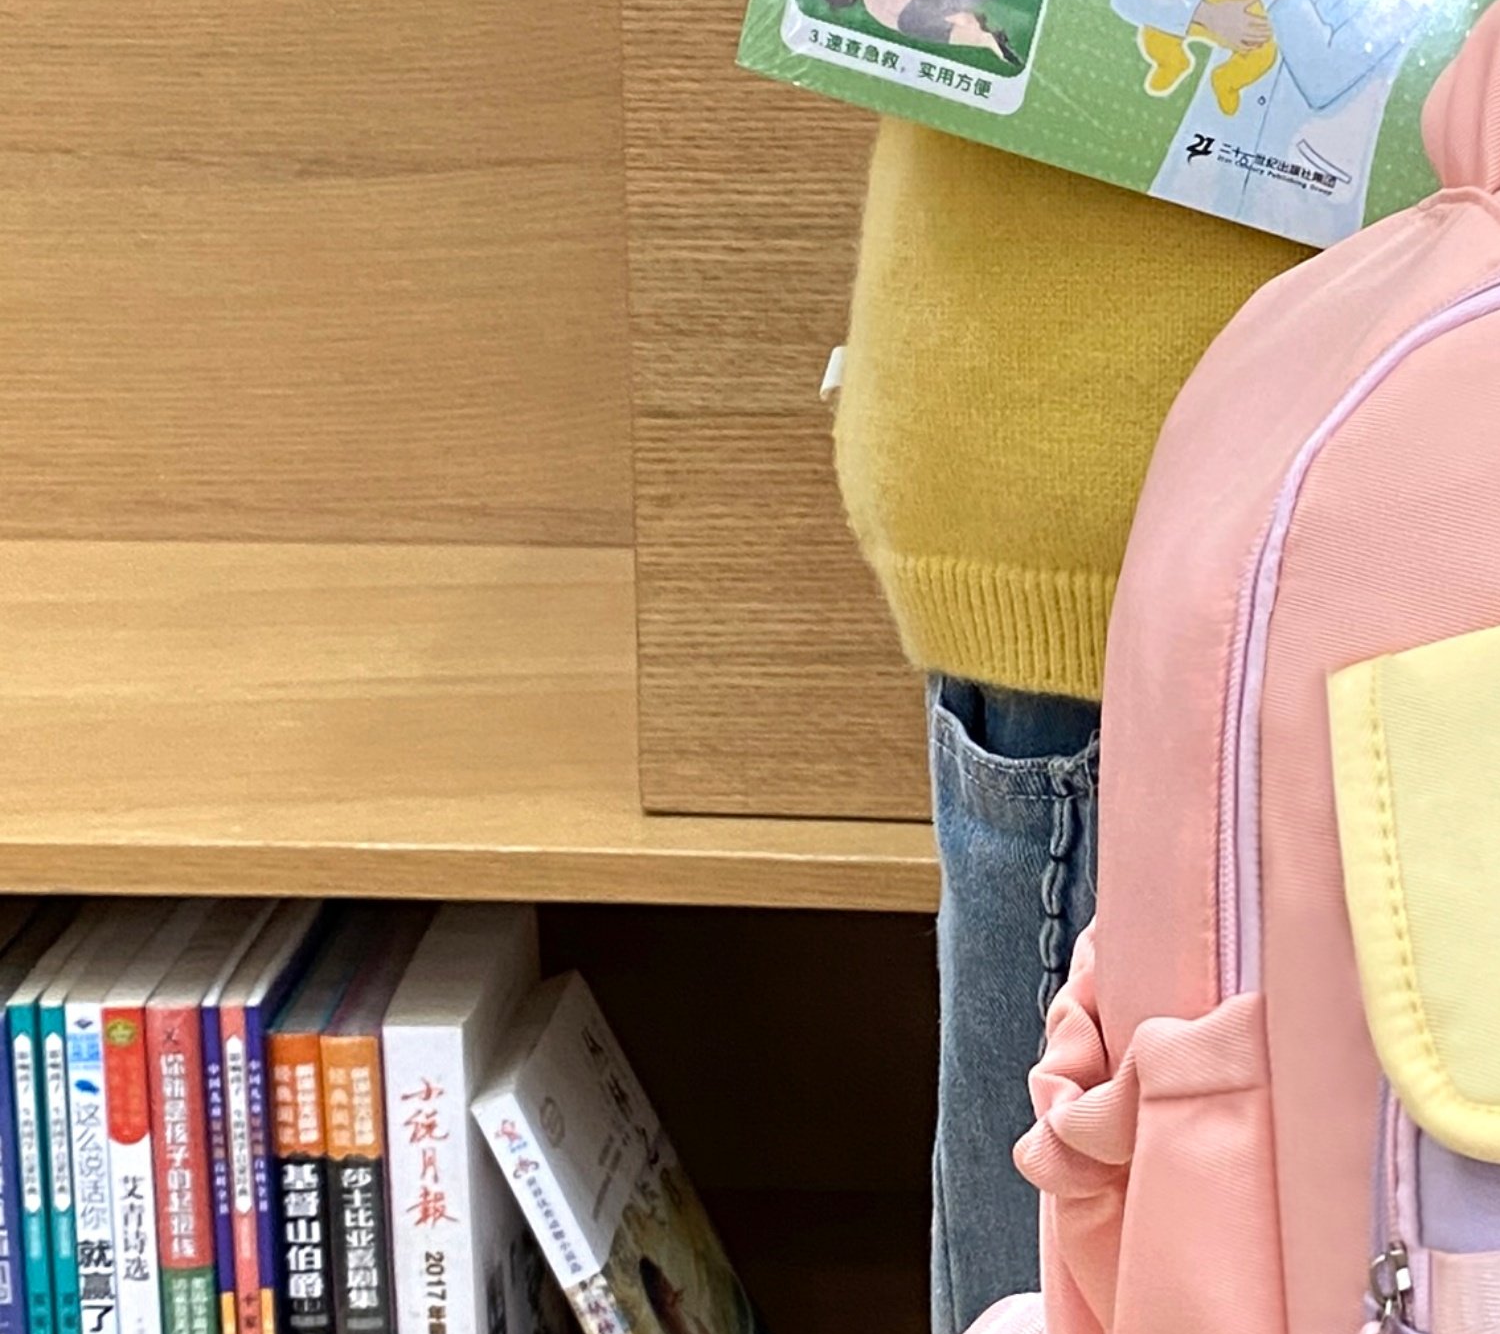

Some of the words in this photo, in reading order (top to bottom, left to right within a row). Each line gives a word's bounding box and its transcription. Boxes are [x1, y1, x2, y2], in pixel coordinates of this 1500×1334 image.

[120, 1175, 150, 1281] 艾青诗选
[282, 1163, 324, 1299] 基督山伯爵
[341, 1167, 379, 1309] 莎士比亚喜剧集
